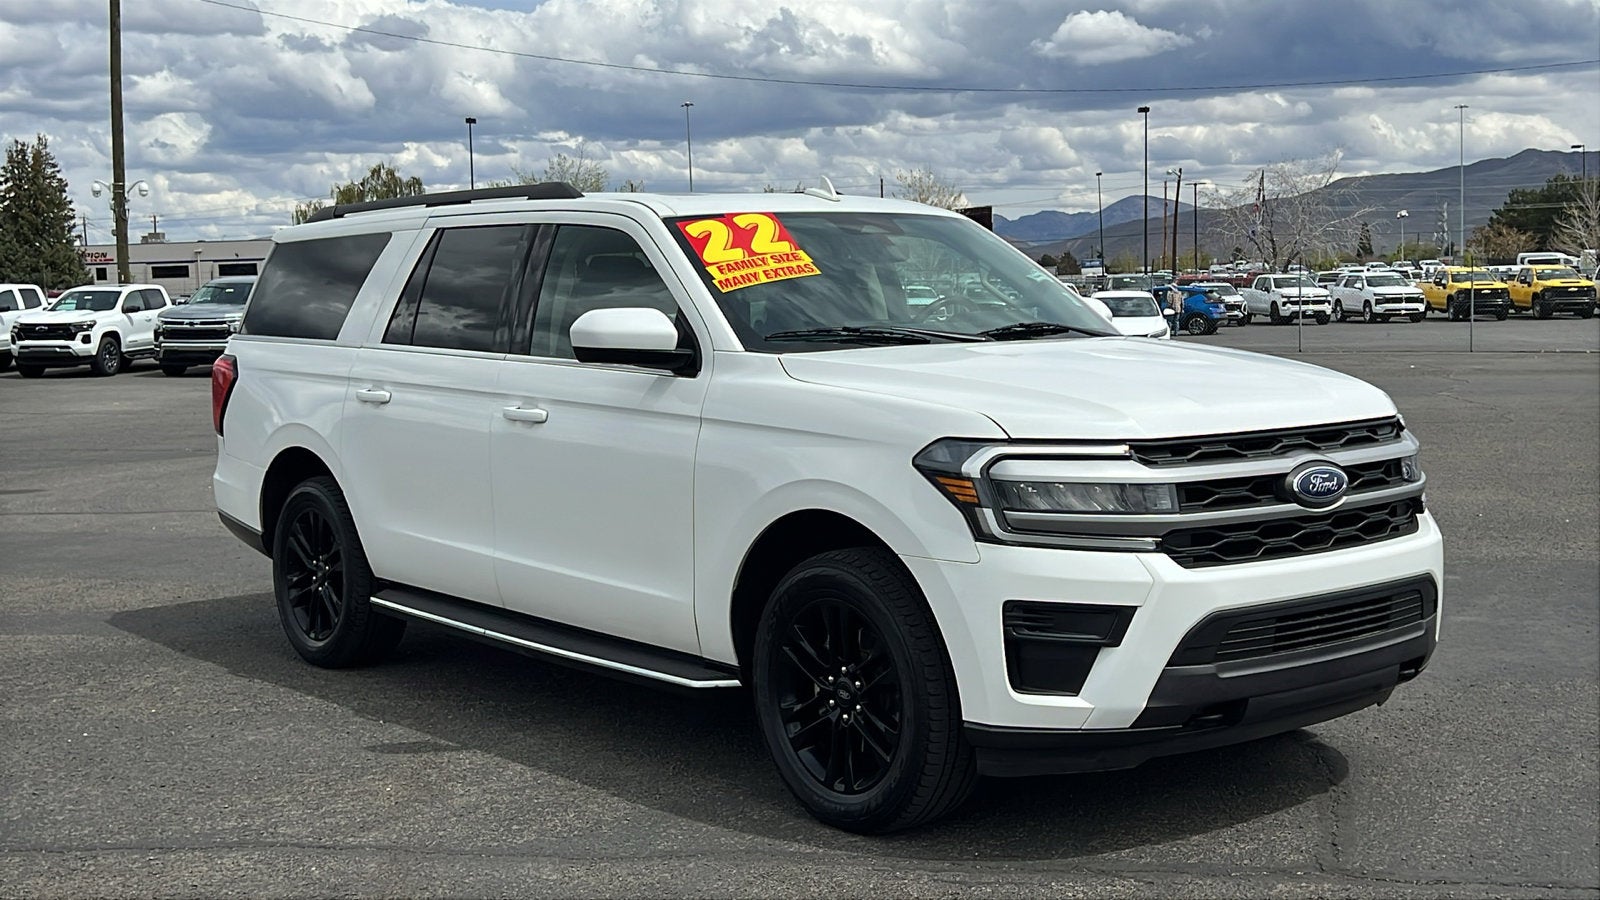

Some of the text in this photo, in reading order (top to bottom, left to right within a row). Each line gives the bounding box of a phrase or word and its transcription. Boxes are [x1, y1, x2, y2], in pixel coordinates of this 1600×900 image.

[685, 213, 795, 263] 22
[716, 252, 803, 275] FAMILY SIZE
[717, 263, 815, 290] MANY EXTRAS
[1309, 473, 1338, 492] Ford
